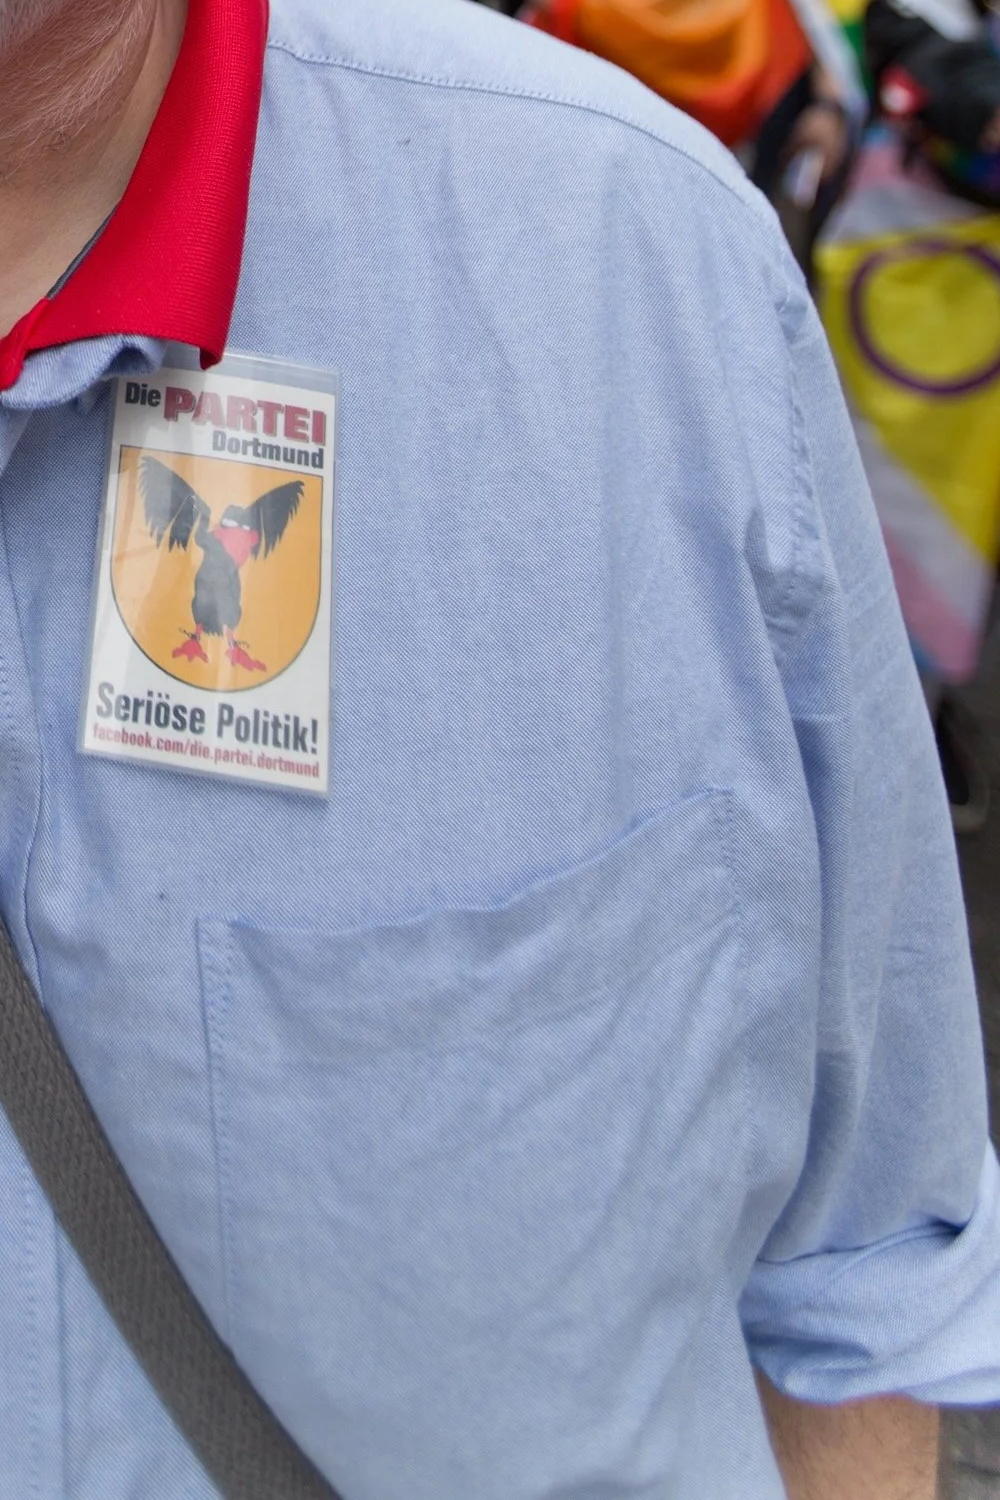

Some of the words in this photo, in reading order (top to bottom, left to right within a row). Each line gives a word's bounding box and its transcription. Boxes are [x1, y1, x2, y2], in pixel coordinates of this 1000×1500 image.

[125, 382, 161, 407] Die
[163, 386, 327, 446] PARTEI
[212, 430, 324, 469] Dortmund
[96, 681, 206, 734] Seriöse
[217, 702, 318, 754] Politik!
[93, 723, 320, 778] facebook.com/die.partei.dortmund
